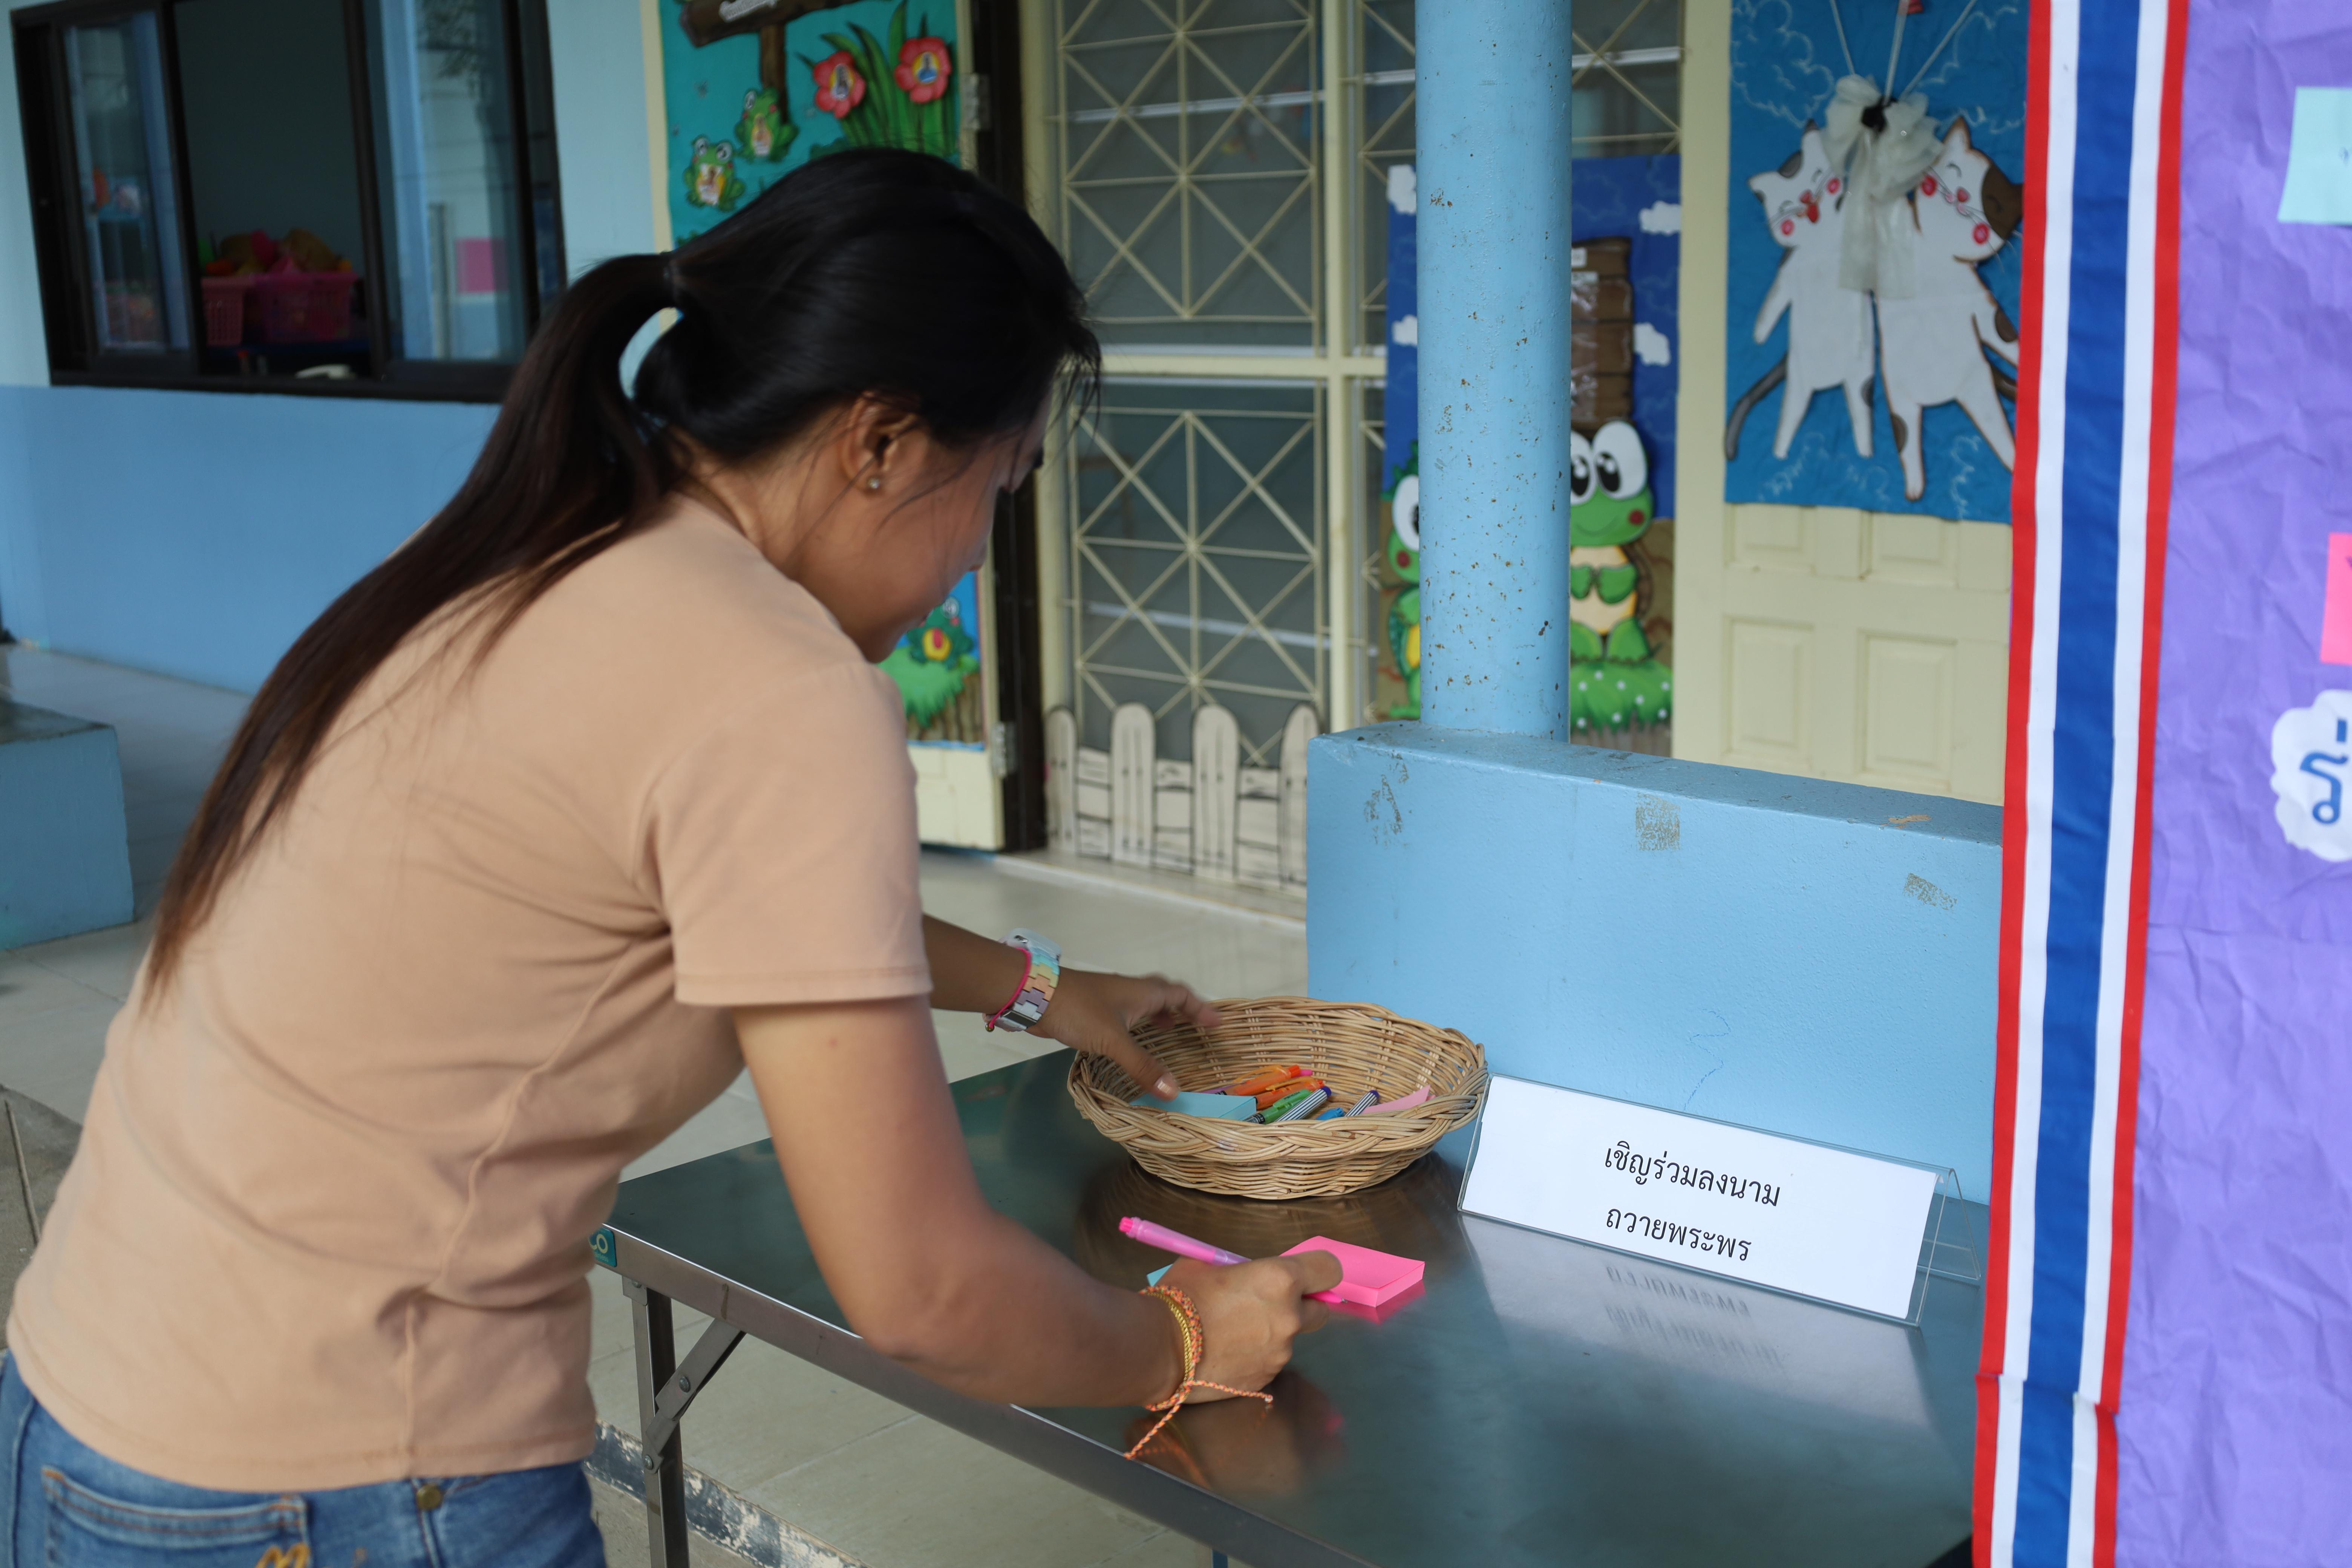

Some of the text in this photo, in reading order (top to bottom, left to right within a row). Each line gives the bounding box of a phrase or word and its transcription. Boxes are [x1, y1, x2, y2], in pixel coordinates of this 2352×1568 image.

[1605, 1141, 1780, 1207] เชิญร่วมลงนาม
[1606, 1209, 1752, 1261] ถวายพระพร
